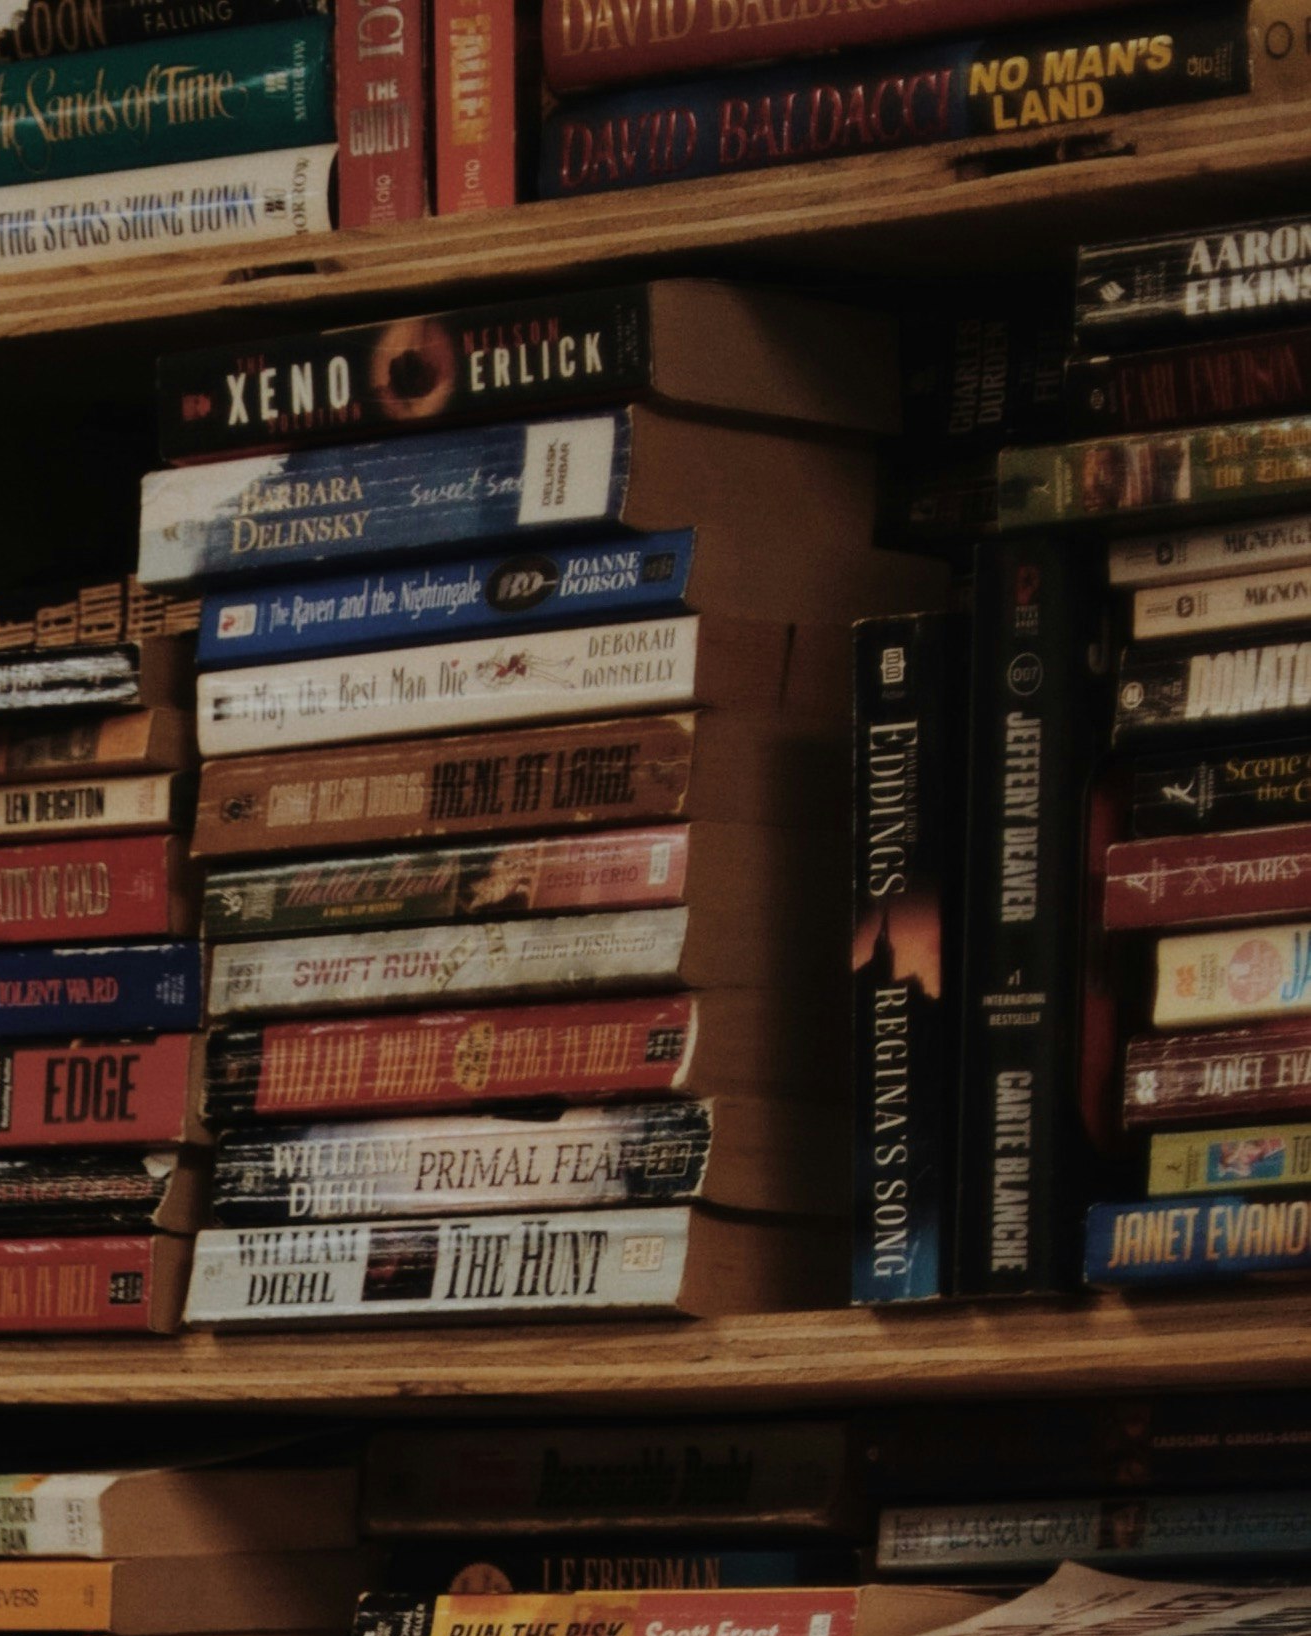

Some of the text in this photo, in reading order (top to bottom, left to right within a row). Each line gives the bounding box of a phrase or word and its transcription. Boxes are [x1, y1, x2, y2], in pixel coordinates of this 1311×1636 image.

[449, 9, 492, 147] FALLEN
[969, 34, 1175, 99] NO MAN'S
[560, 67, 955, 190] DAVID BALDACCI
[992, 84, 1106, 132] LAND
[41, 201, 111, 251] STARS
[115, 194, 184, 243] SHINE
[189, 182, 258, 233] DOWN
[225, 356, 351, 428] XENO
[470, 332, 603, 392] ERLICK
[237, 474, 365, 516] BARBARA
[230, 511, 372, 556] DELINSKY
[558, 550, 641, 579] JOANNE
[558, 569, 639, 598] DOBSON
[269, 565, 482, 633] The Raven and the Nightingale
[586, 626, 677, 658] DEBORAH
[581, 657, 677, 690] DONNELLY
[43, 1053, 140, 1126] EDGE
[872, 985, 910, 1279] REGINA'S SONG
[415, 1139, 641, 1191] PRIMAL FEAR
[990, 1070, 1034, 1273] CARTE BLANCHE
[237, 1229, 359, 1266] WILLIAM
[445, 1221, 610, 1300] THE HUNT
[247, 1271, 336, 1307] DIEHL
